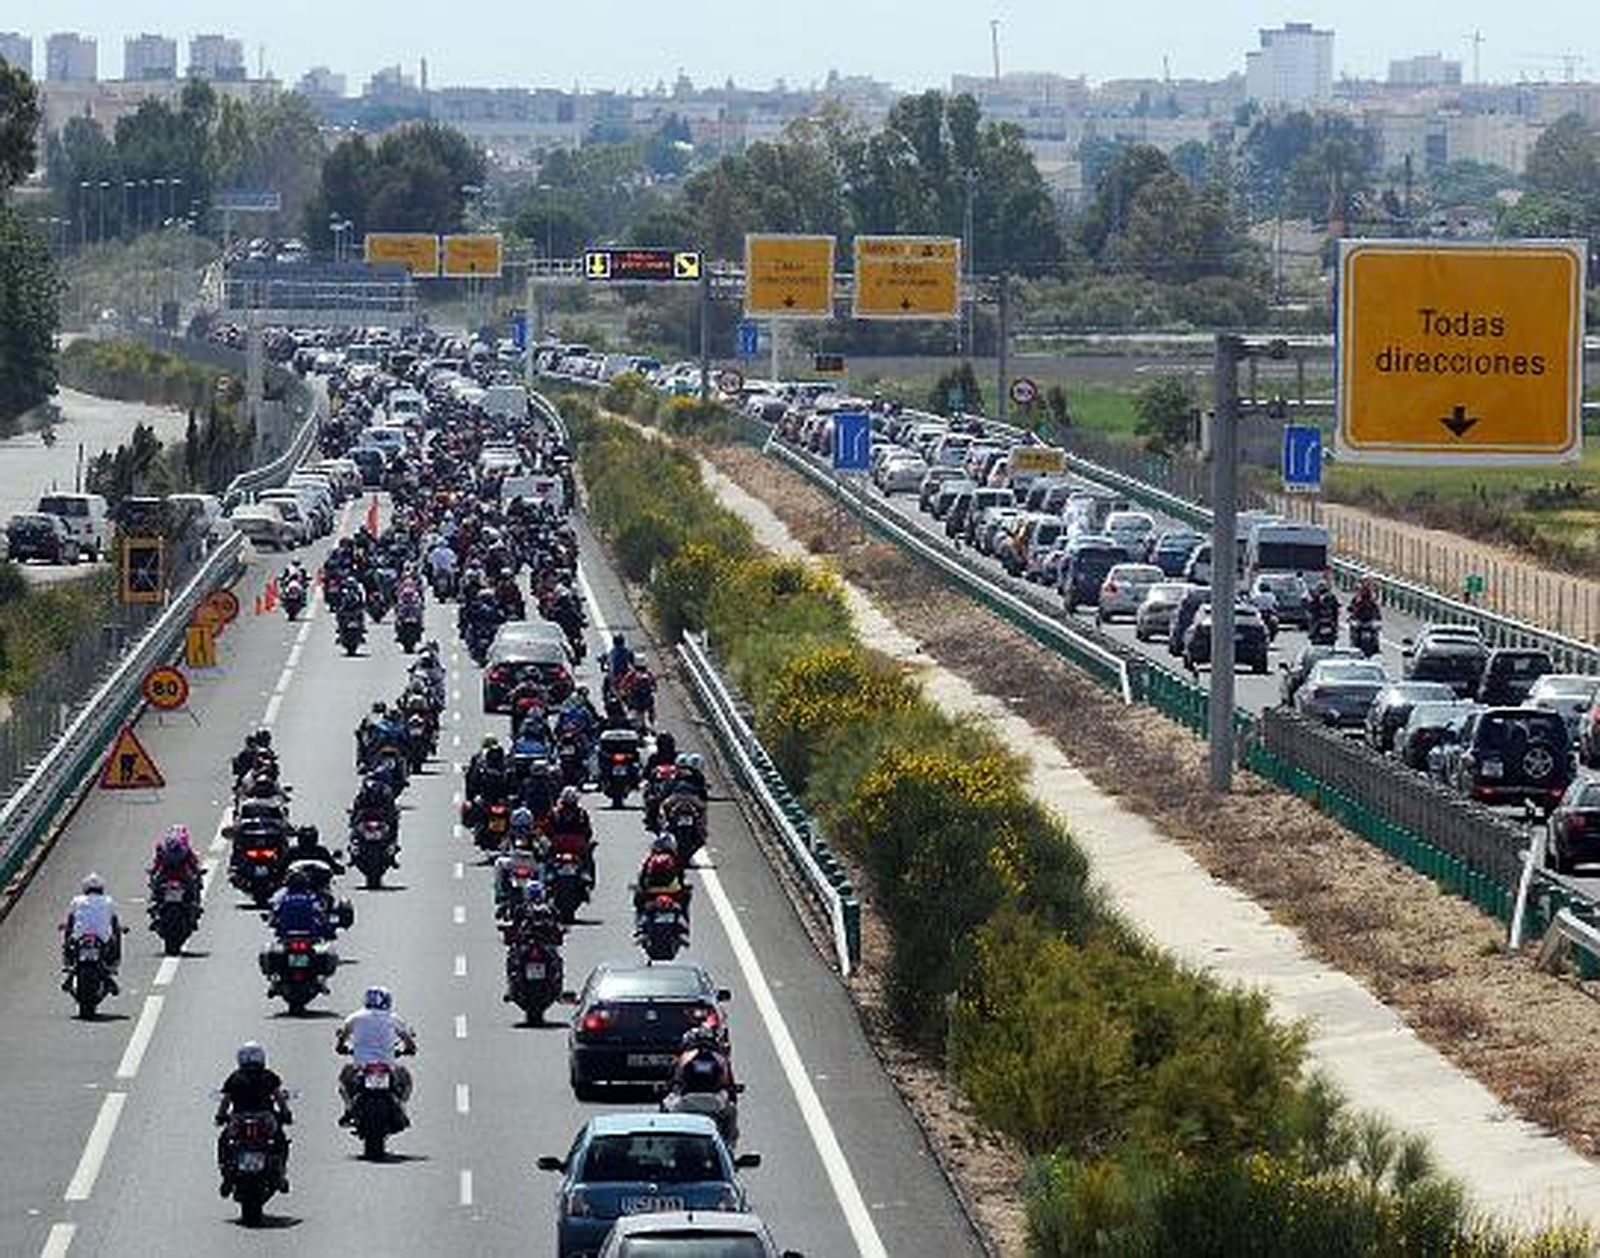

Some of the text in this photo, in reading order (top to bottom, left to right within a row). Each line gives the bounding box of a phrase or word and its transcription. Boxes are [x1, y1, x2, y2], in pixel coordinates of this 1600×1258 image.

[1418, 308, 1505, 338] Todas
[1375, 346, 1546, 376] direcciones
[152, 681, 178, 697] 80
